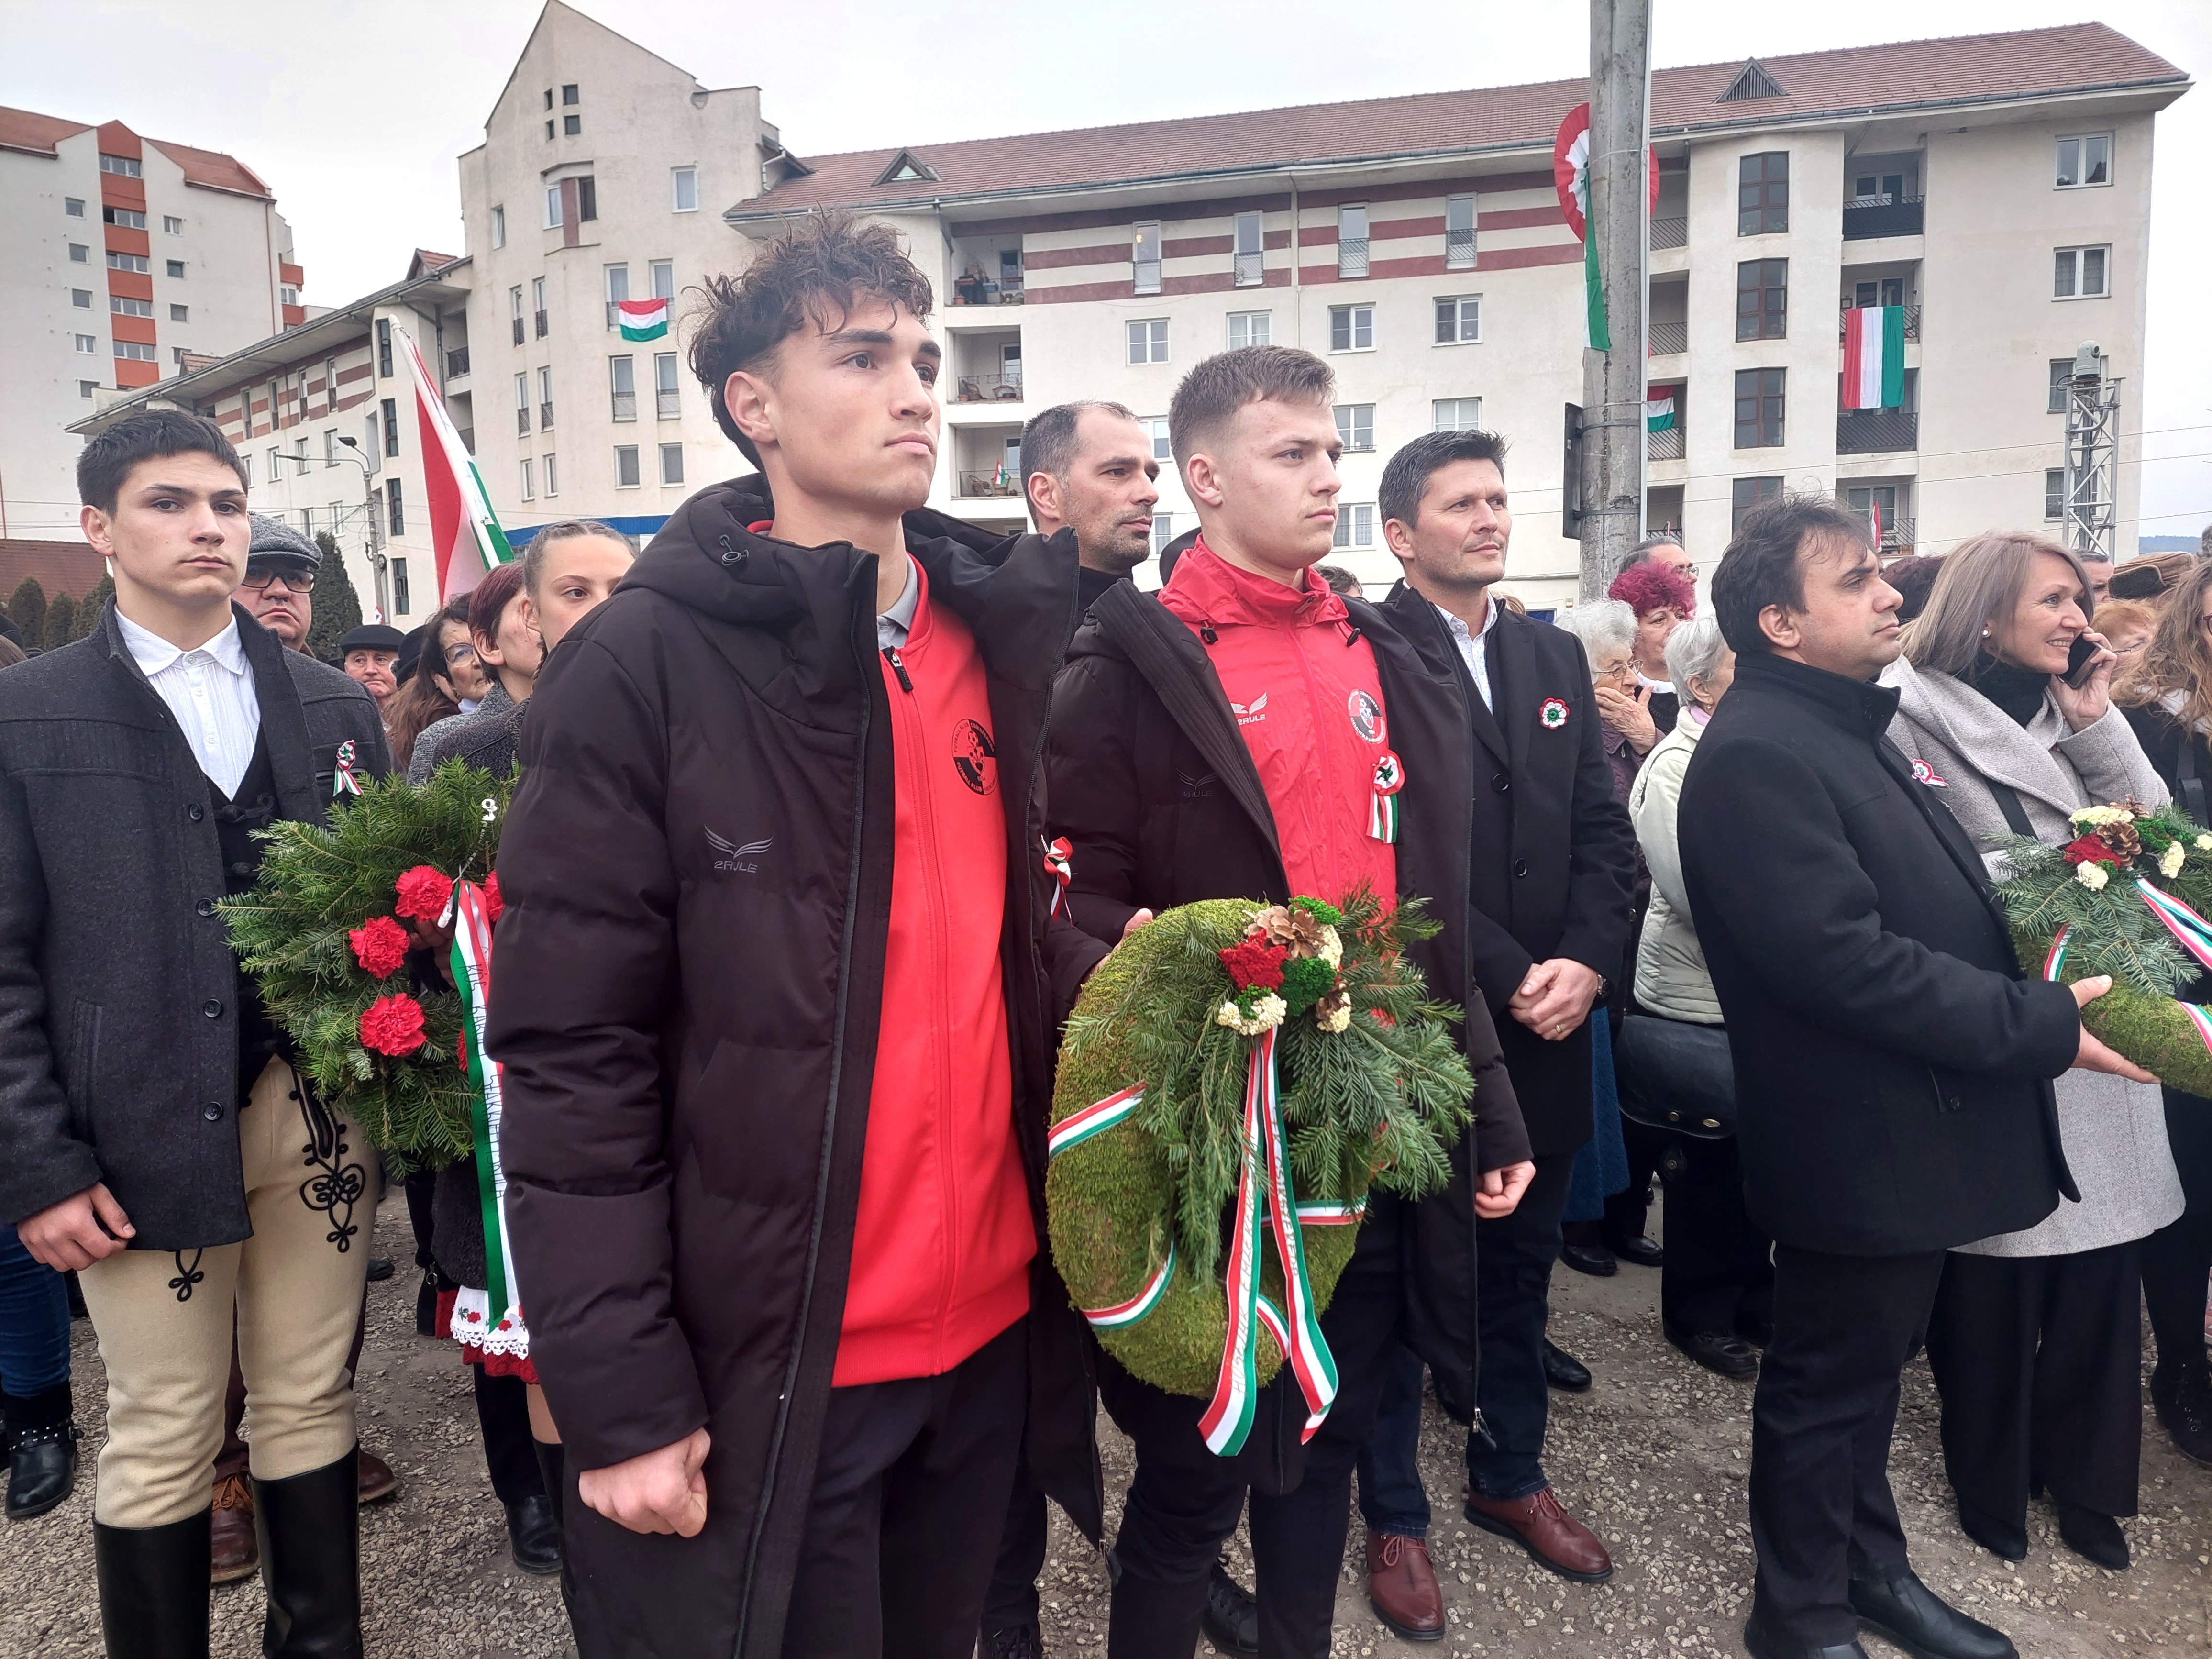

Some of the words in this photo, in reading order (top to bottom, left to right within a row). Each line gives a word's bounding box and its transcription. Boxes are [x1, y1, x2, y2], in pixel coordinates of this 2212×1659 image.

[1237, 714, 1266, 726] 2RULE
[957, 762, 971, 785] FUTBALL
[971, 782, 983, 792] KLUB
[714, 861, 758, 874] 2RULE
